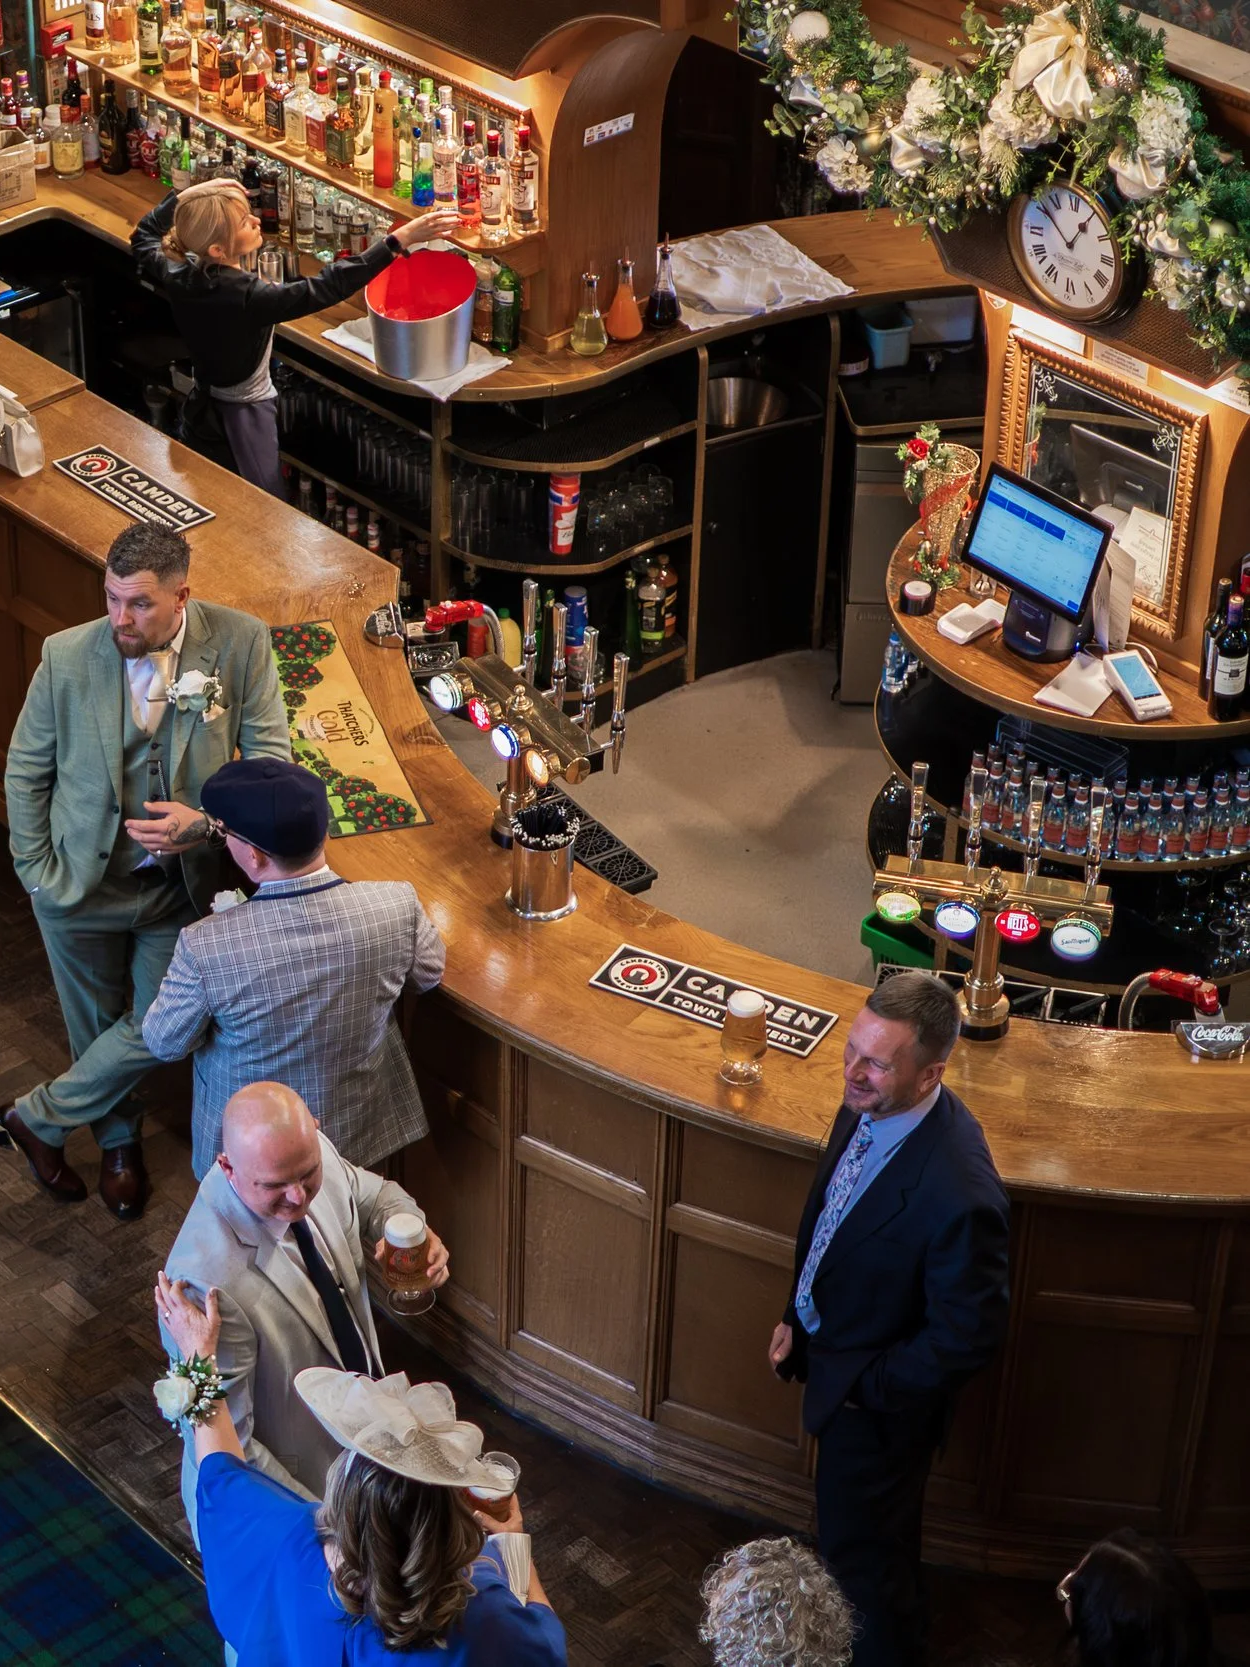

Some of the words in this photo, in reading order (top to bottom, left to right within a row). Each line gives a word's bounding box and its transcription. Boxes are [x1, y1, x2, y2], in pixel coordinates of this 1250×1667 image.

[100, 483, 129, 503] TOWN
[121, 473, 201, 521] CAMDEN
[317, 710, 350, 744] Gold
[337, 700, 370, 746] THATCHERS
[1006, 917, 1030, 932] HELLS
[673, 996, 720, 1019] TOWN
[686, 976, 820, 1030] CADEN
[1191, 1025, 1245, 1042] Coca-Cola
